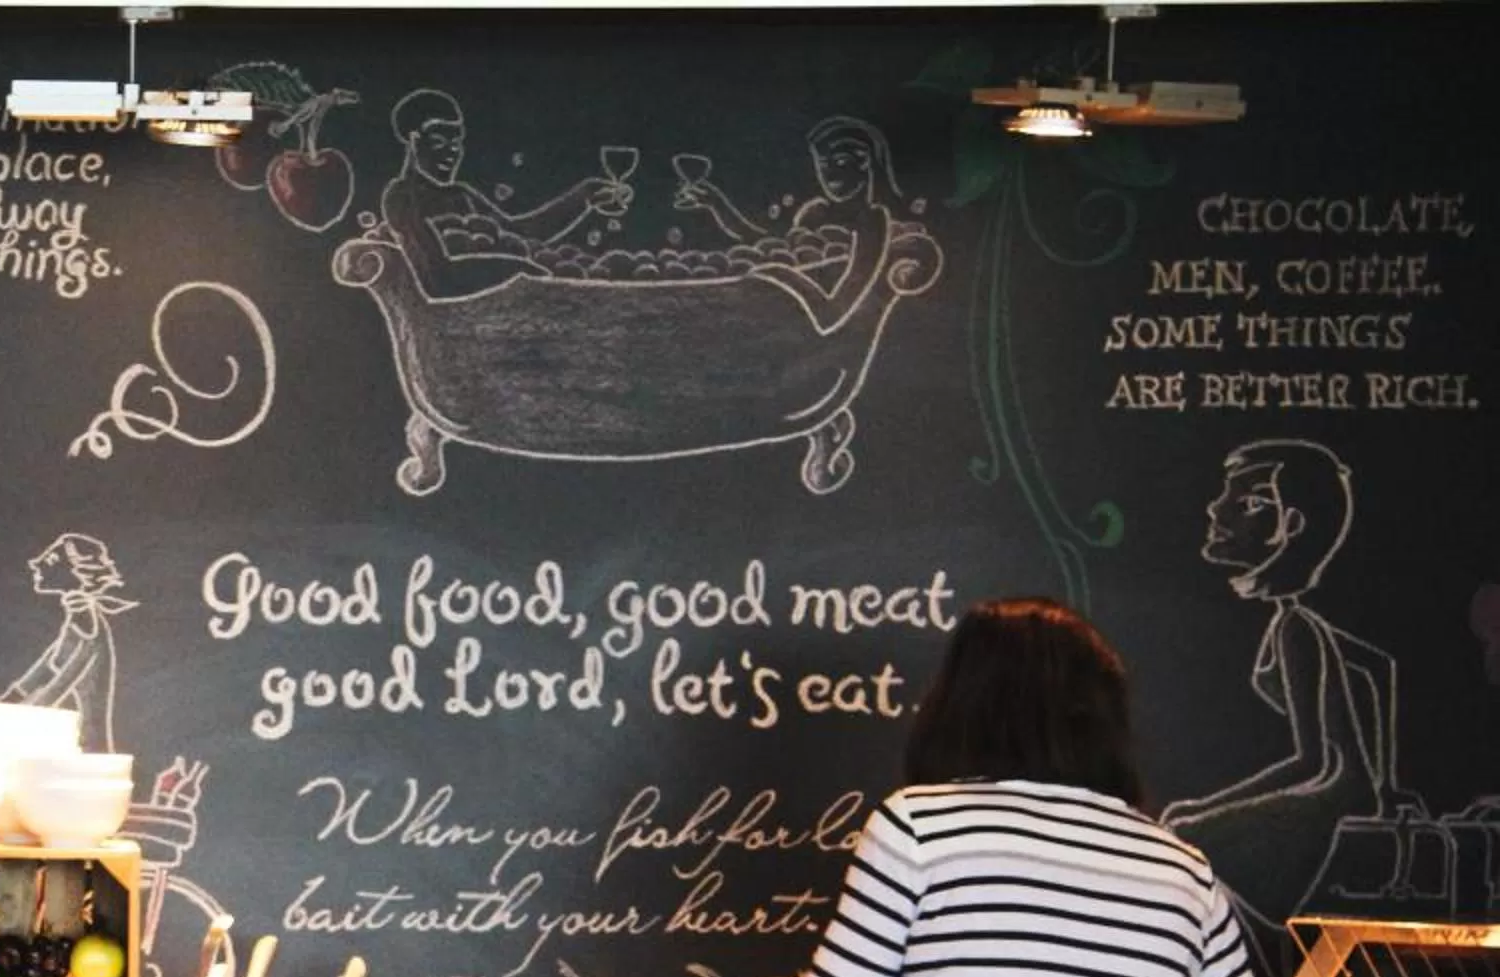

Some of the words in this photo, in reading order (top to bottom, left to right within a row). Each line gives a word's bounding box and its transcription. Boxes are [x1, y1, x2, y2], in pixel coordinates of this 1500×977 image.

[1199, 192, 1476, 237] CHOCOLATE,
[1147, 257, 1260, 300] MEN,
[1104, 313, 1224, 352] SOME
[1236, 312, 1412, 350] THINGS
[1105, 370, 1188, 411] ARE
[1200, 370, 1356, 411] BETTER
[1365, 372, 1480, 410] RICH.
[201, 551, 382, 642] Good
[403, 552, 589, 648] food,
[599, 559, 770, 660] good
[251, 642, 424, 741] good
[443, 636, 627, 728] Lord,
[651, 640, 785, 730] let's
[797, 662, 921, 719] eat.
[297, 776, 498, 847] When
[490, 824, 598, 886] you
[594, 786, 730, 883] fish
[672, 789, 811, 879] for
[283, 876, 416, 933] bait
[402, 871, 543, 934] with
[664, 870, 830, 936] heart.
